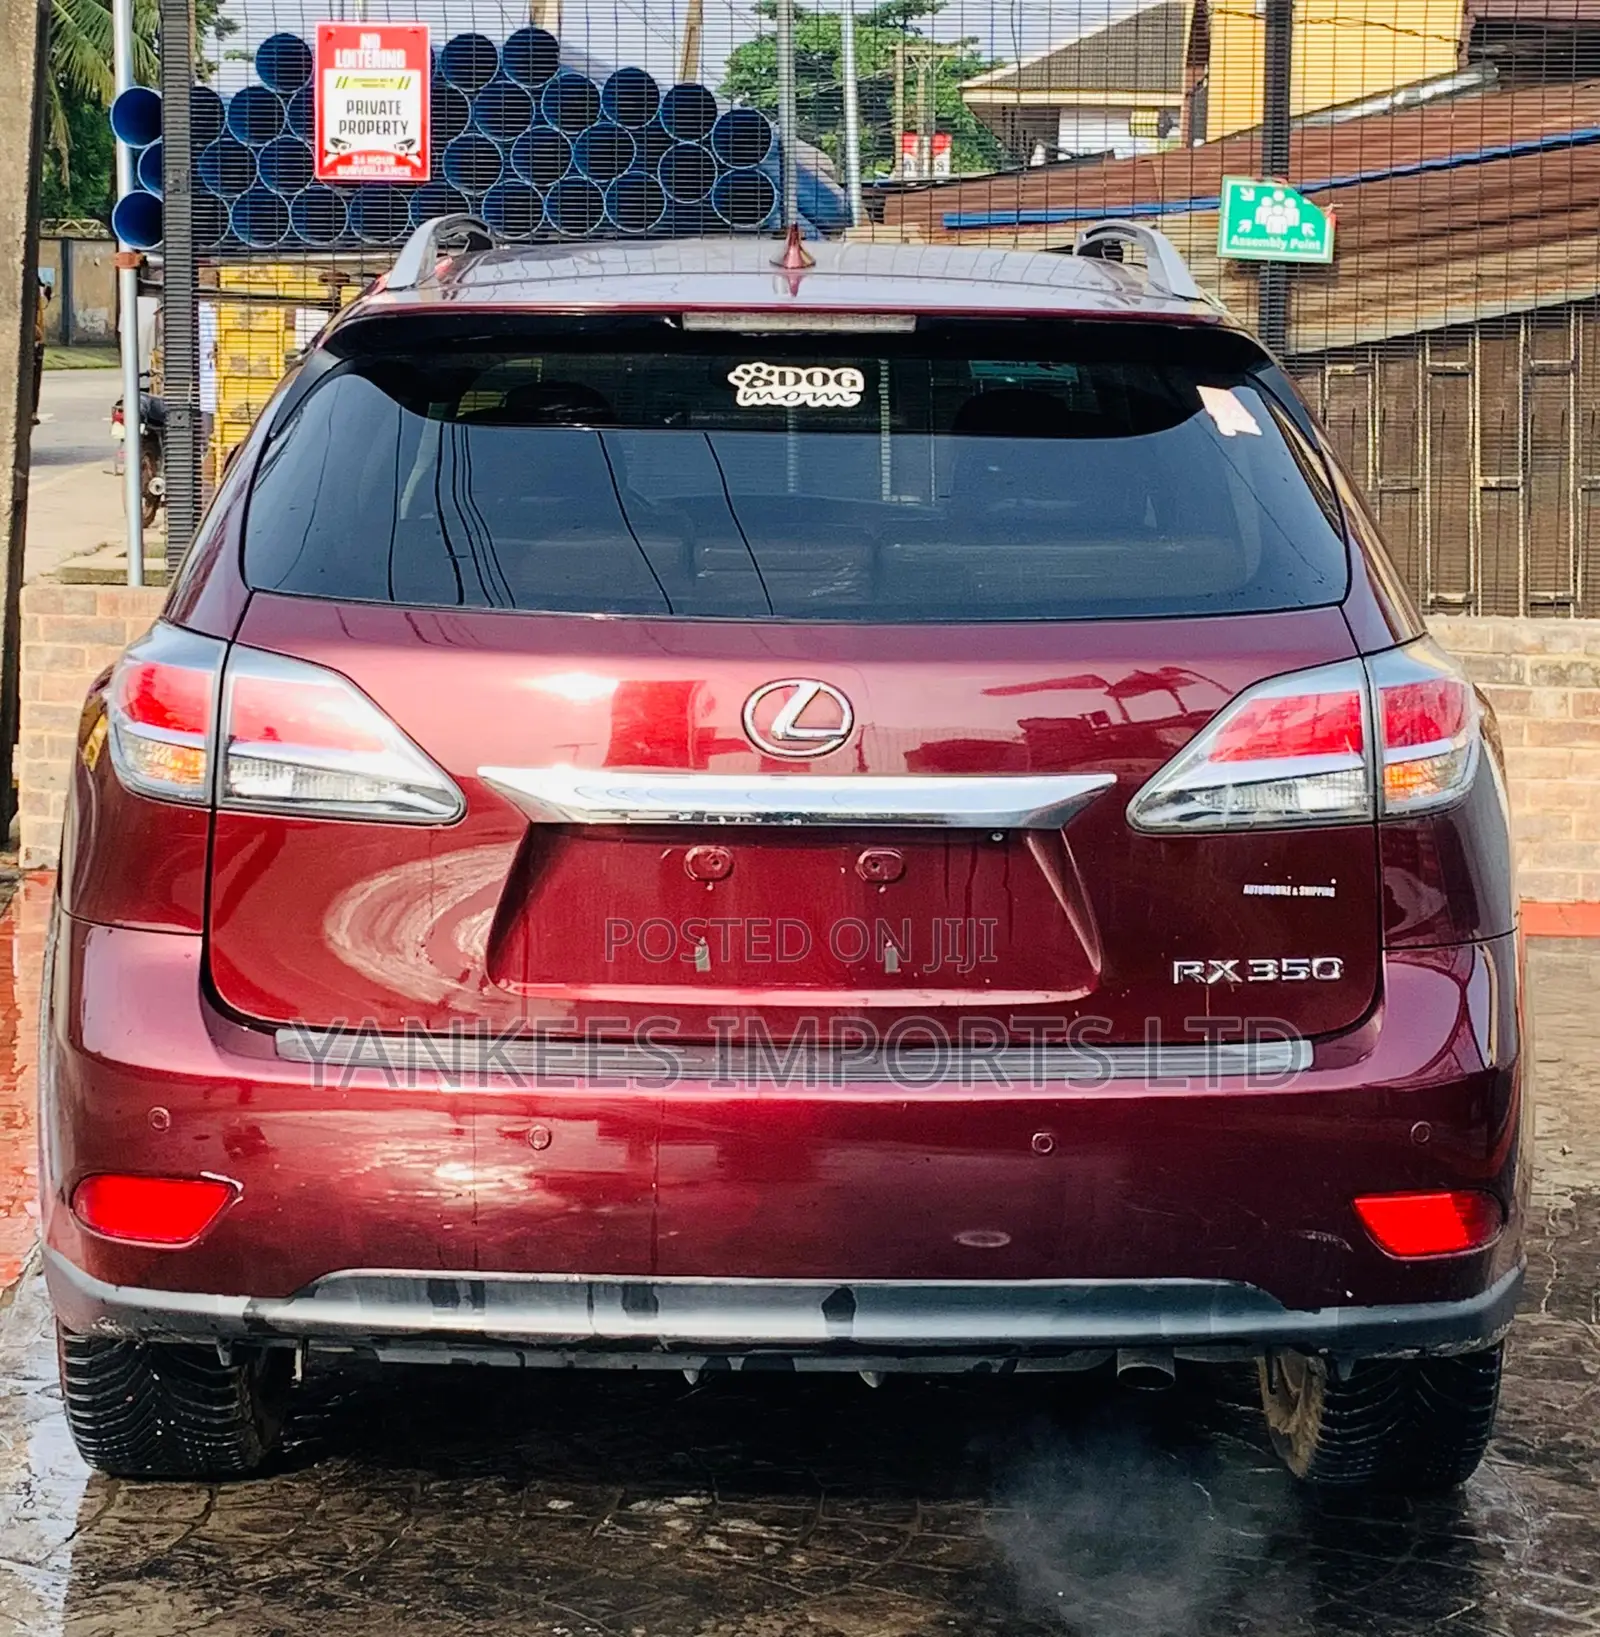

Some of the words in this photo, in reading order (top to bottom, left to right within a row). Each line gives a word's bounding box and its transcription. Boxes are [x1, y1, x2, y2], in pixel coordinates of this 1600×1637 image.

[360, 32, 381, 49] NO
[335, 49, 406, 68] LOITERING
[346, 99, 402, 115] PRIVATE
[339, 120, 409, 135] PROPERTY
[1231, 235, 1288, 251] Assembly
[1290, 238, 1321, 250] Point
[778, 370, 858, 387] DOG
[743, 391, 854, 402] mom
[1173, 959, 1244, 984] RX
[1247, 957, 1344, 980] 350
